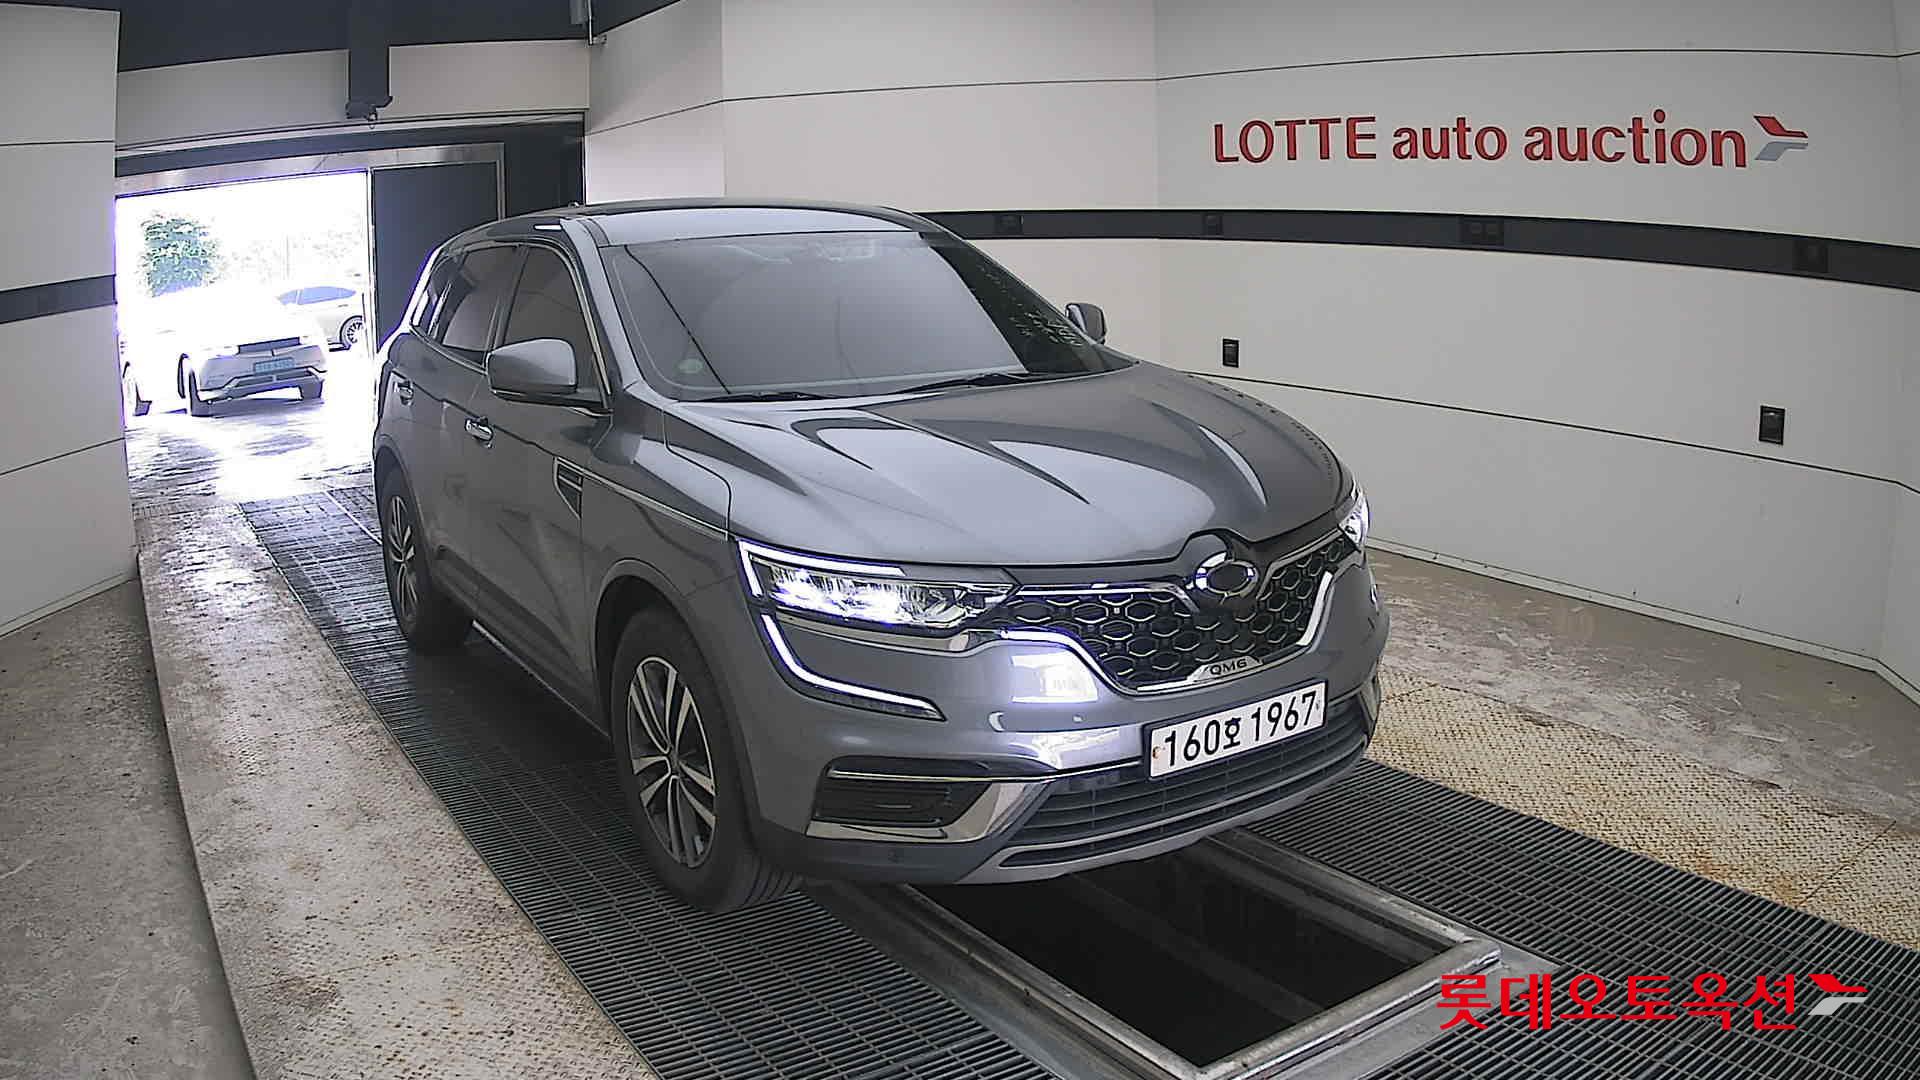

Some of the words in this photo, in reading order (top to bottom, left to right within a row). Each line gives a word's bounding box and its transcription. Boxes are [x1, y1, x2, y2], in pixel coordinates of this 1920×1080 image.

[1214, 116, 1376, 163] LOTTE
[1392, 117, 1508, 161] auto
[1524, 109, 1747, 168] auction
[1210, 658, 1248, 675] QM6
